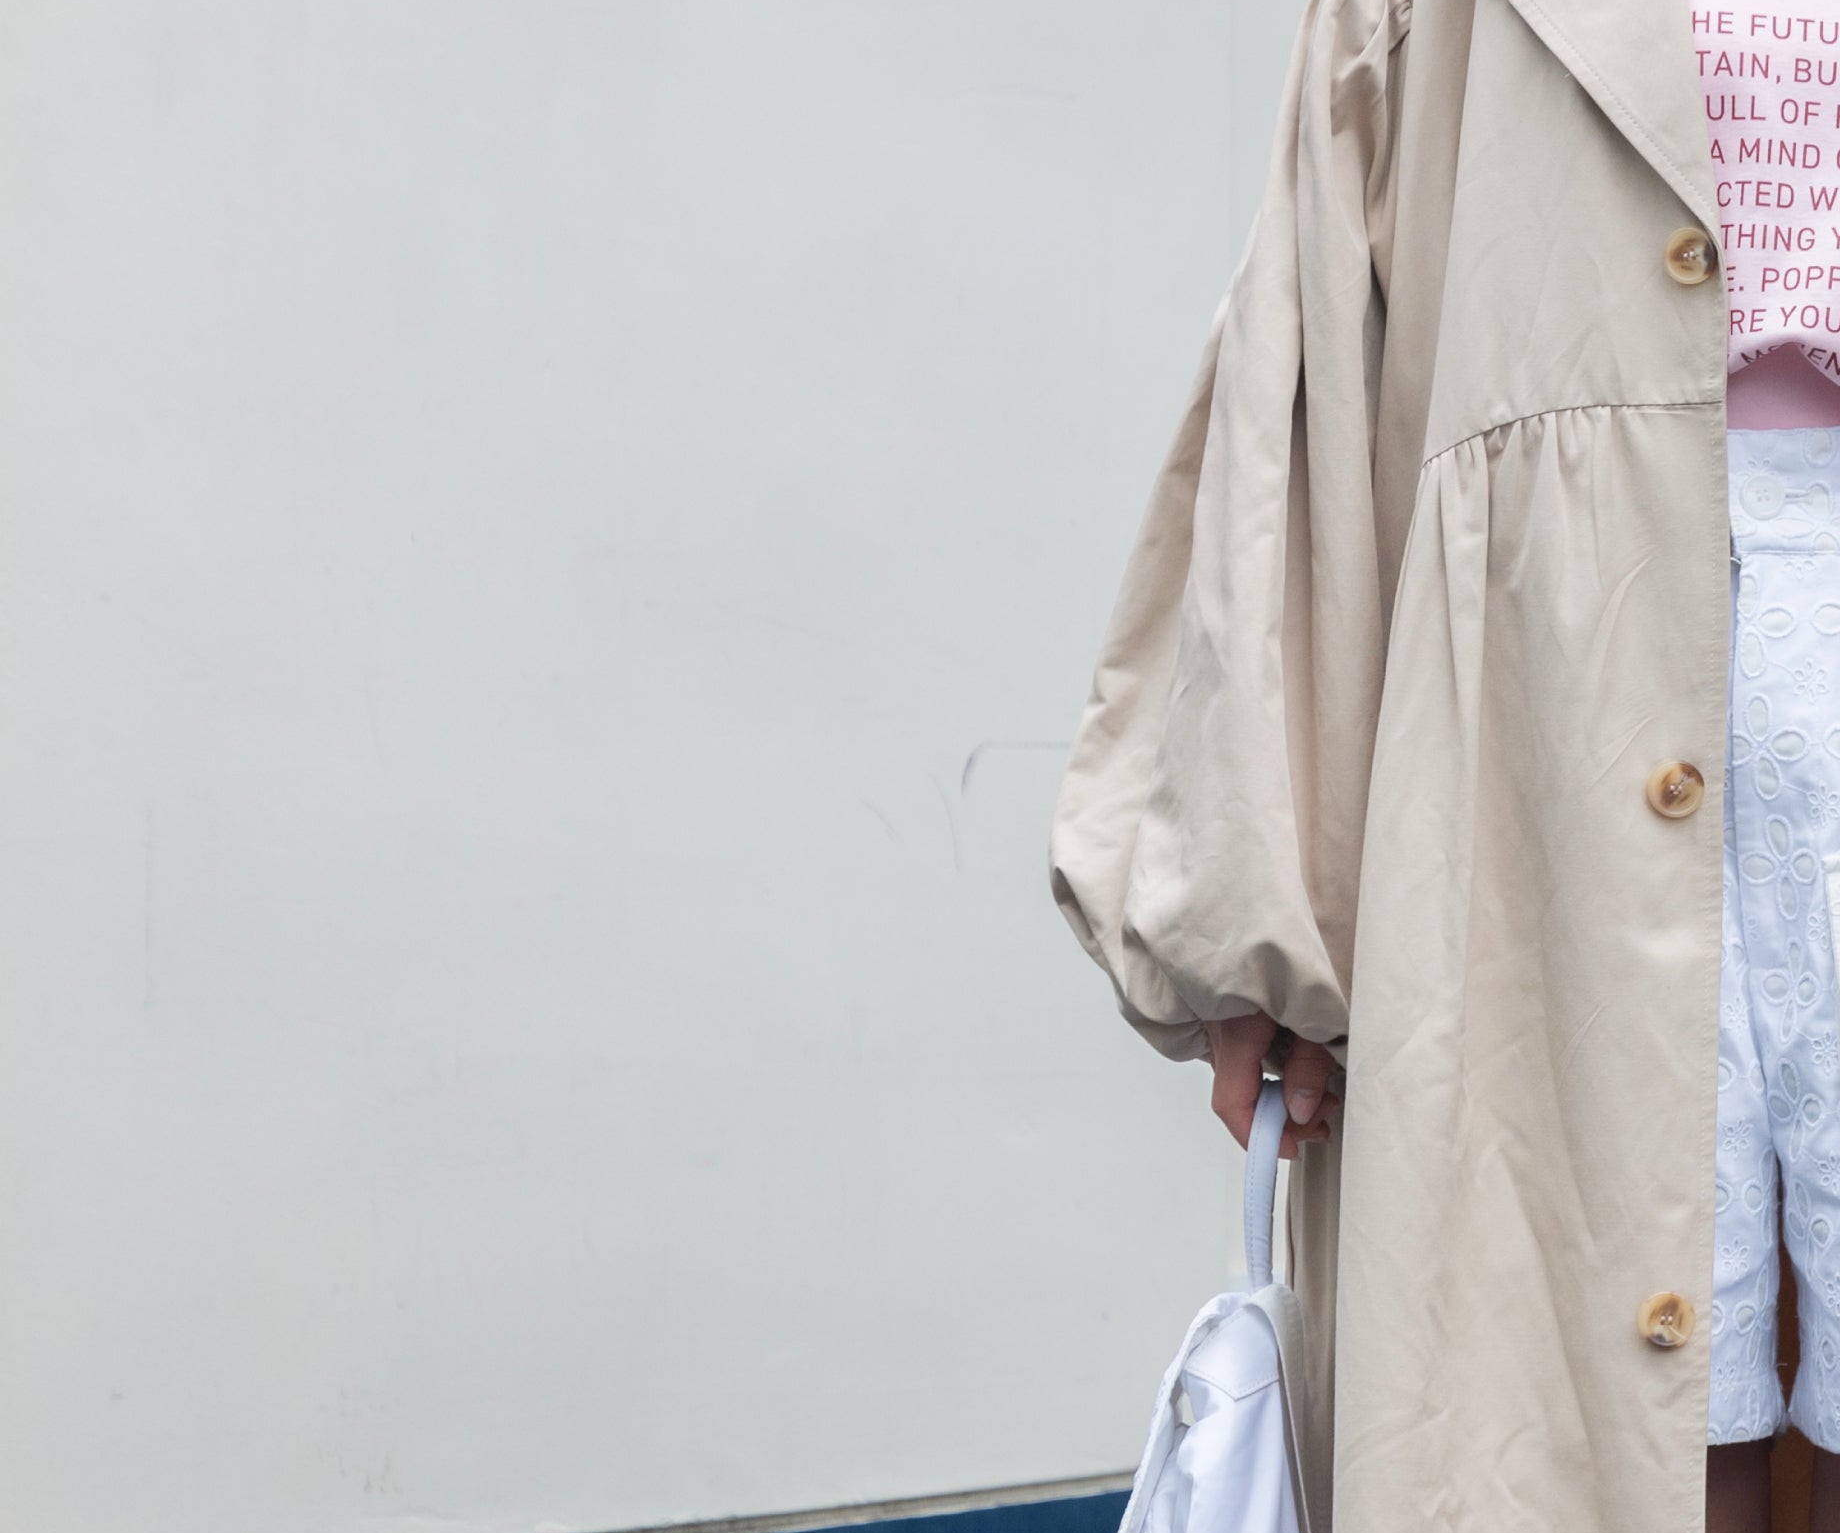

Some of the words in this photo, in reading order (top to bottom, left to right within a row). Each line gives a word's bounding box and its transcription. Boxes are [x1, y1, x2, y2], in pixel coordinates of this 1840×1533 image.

[1692, 11, 1734, 34] HE
[1695, 50, 1781, 84] TAIN,
[1706, 95, 1766, 121] ULL
[1780, 98, 1821, 126] OF
[1710, 139, 1725, 164] A
[1739, 138, 1821, 169] MIND
[1714, 180, 1795, 210] CTED
[1720, 223, 1816, 252] THING
